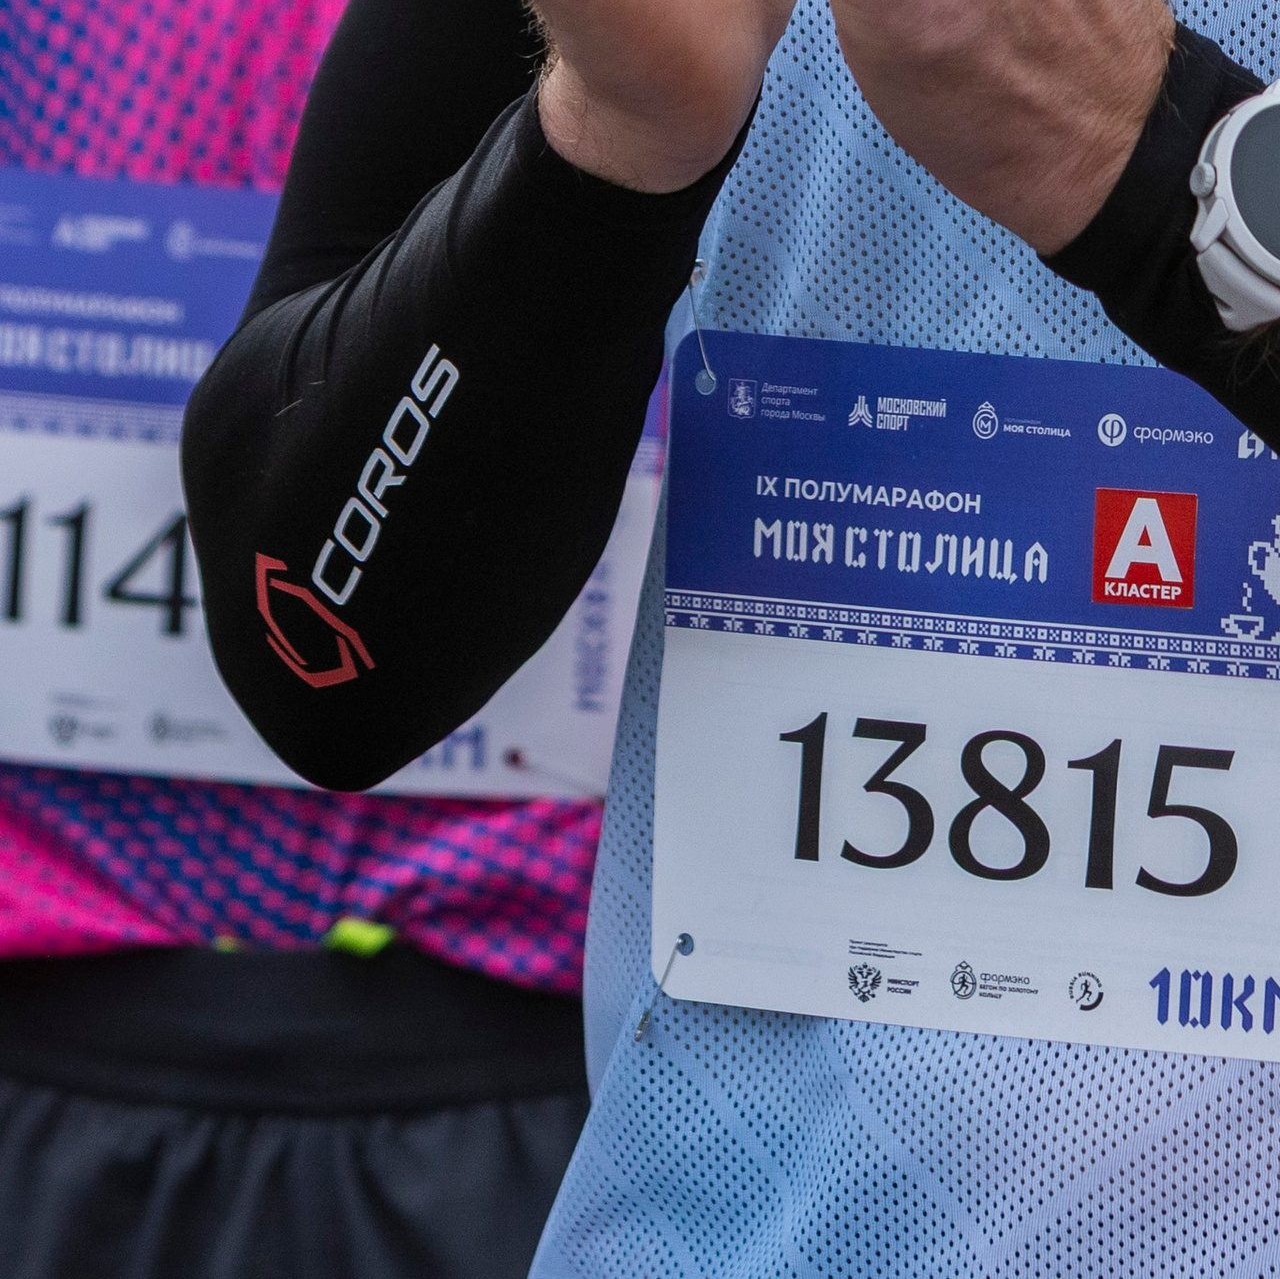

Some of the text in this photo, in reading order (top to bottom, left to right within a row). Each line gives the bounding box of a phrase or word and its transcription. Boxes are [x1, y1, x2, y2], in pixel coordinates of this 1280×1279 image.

[761, 382, 818, 396] Департамент
[761, 396, 791, 408] спорта
[877, 396, 947, 418] МОСКОВСКИЙ
[760, 409, 826, 422] города Москвы
[876, 413, 910, 431] СПОРТ
[1003, 424, 1072, 438] МОЯ СТОЛИЦА
[1133, 425, 1215, 445] фармэко
[311, 343, 460, 605] COROS
[756, 475, 982, 514] IX ПОЛУМАРАФОН
[1104, 497, 1184, 583] А
[1103, 581, 1183, 601] КЛАСТЕР
[779, 711, 1239, 897] 13815
